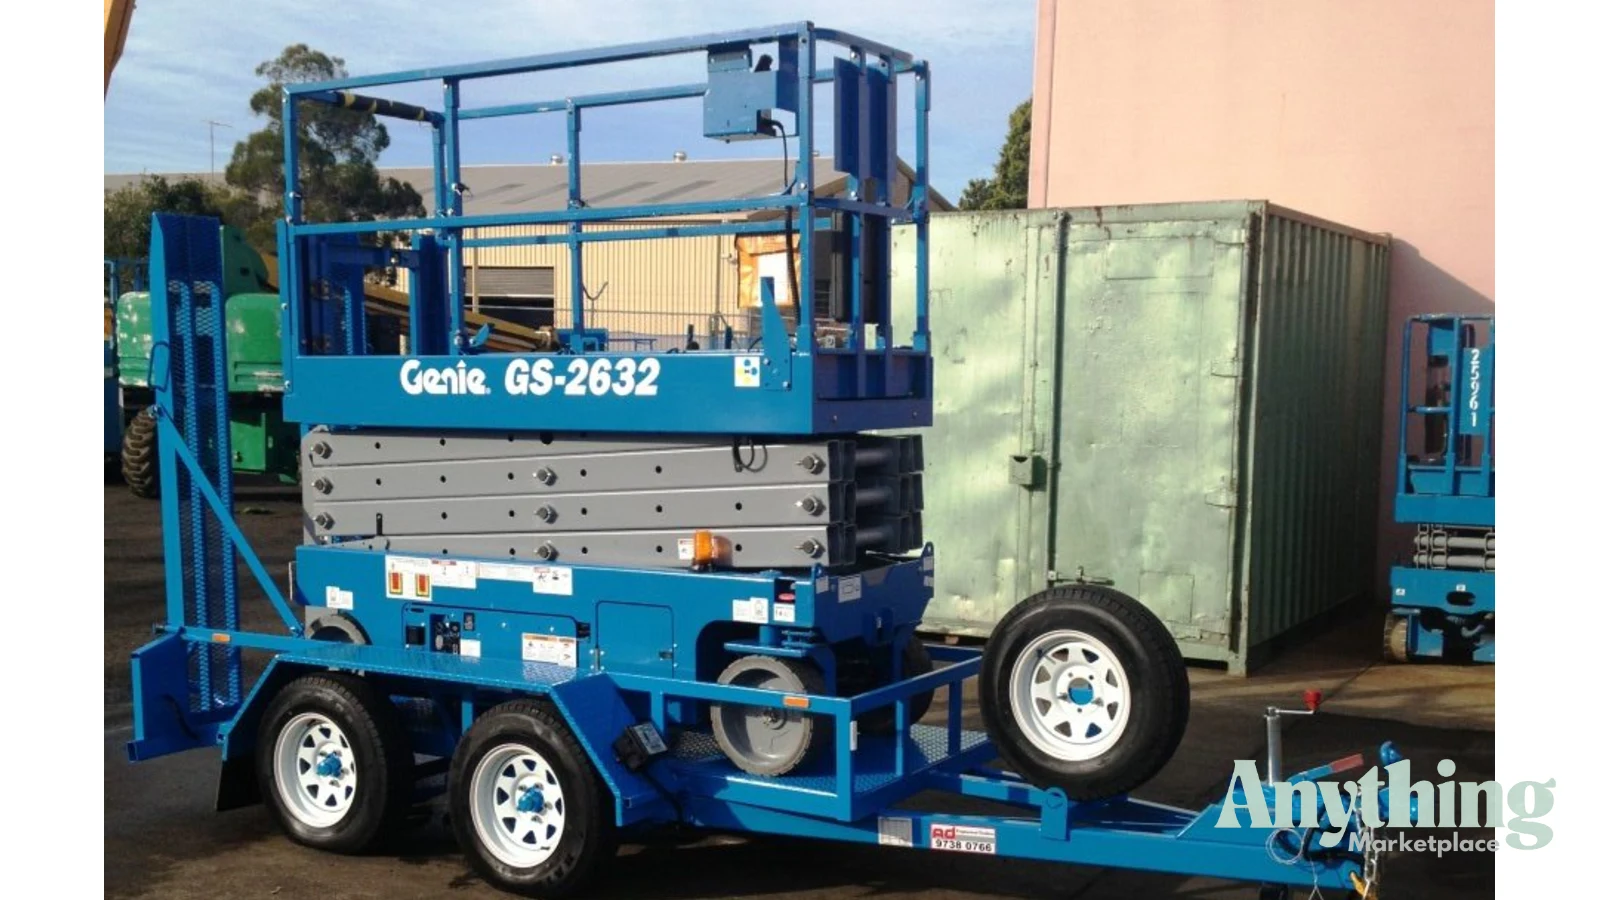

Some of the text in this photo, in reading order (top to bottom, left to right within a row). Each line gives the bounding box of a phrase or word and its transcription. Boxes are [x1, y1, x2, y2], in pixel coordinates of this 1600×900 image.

[400, 357, 661, 396] Genie GS-2632
[1469, 348, 1480, 427] 25961
[935, 839, 962, 849] 9738
